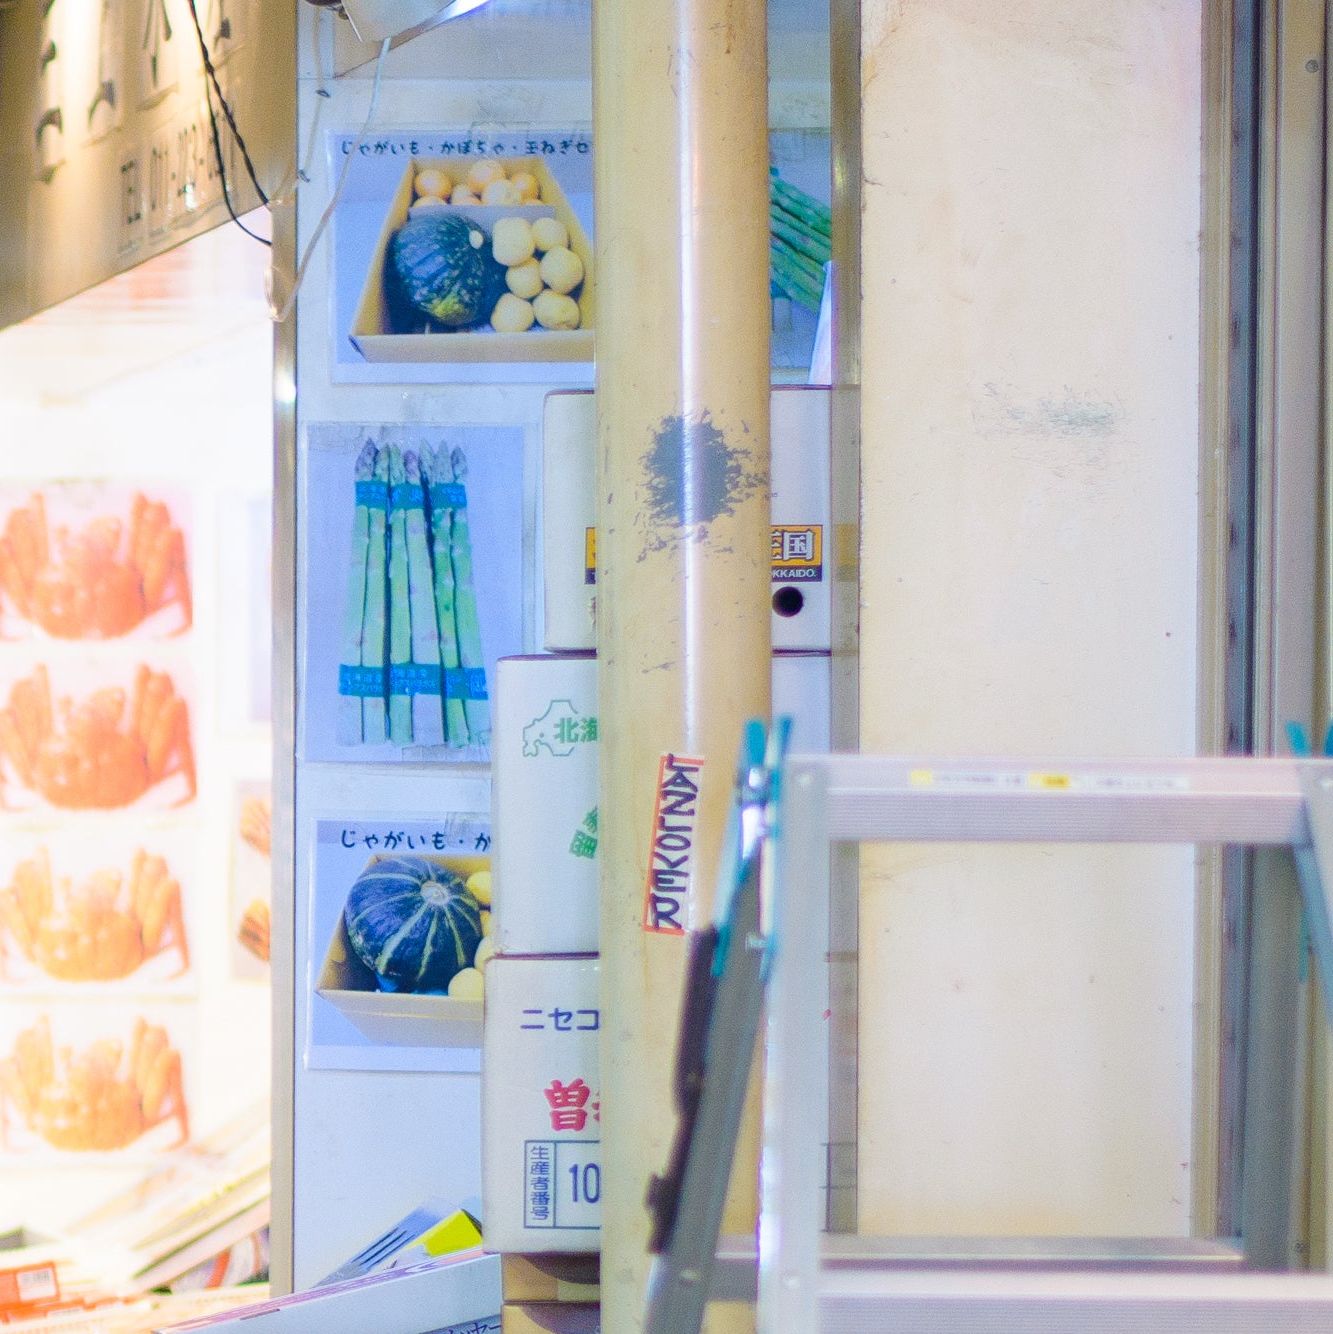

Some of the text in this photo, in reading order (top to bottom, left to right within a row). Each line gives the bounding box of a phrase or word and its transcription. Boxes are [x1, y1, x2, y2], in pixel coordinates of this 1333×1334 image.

[520, 1007, 600, 1031] ニセコ
[530, 1145, 550, 1221] 生産者番号
